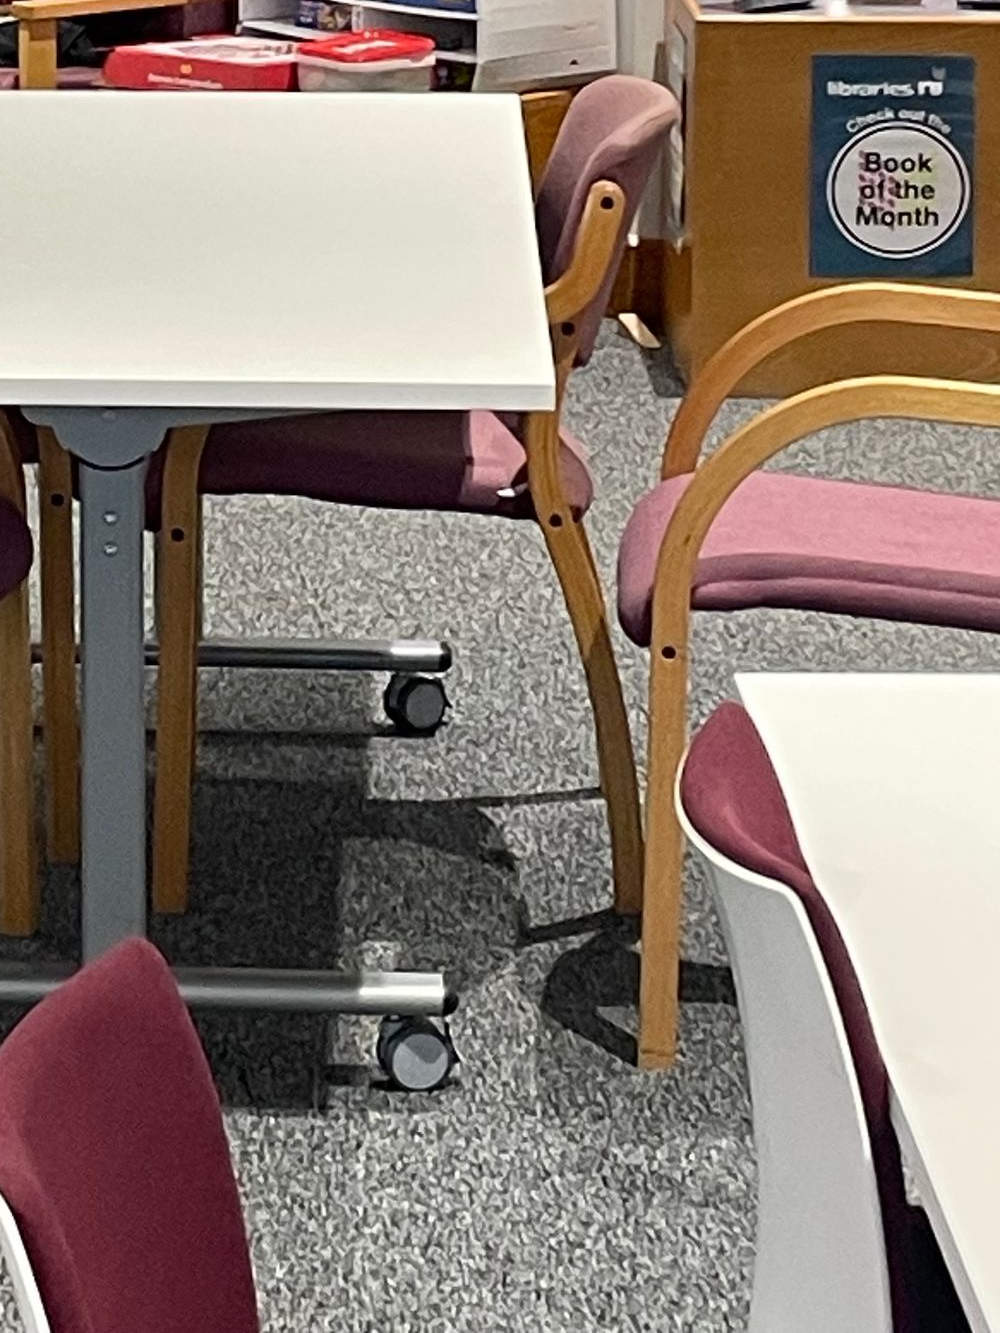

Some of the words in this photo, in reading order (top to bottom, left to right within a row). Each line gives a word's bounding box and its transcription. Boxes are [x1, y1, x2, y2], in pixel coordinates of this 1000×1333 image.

[826, 80, 915, 97] libraries
[846, 107, 895, 133] Check
[864, 152, 933, 173] Book
[860, 179, 886, 200] of
[894, 179, 936, 200] the
[855, 206, 940, 227] Month
